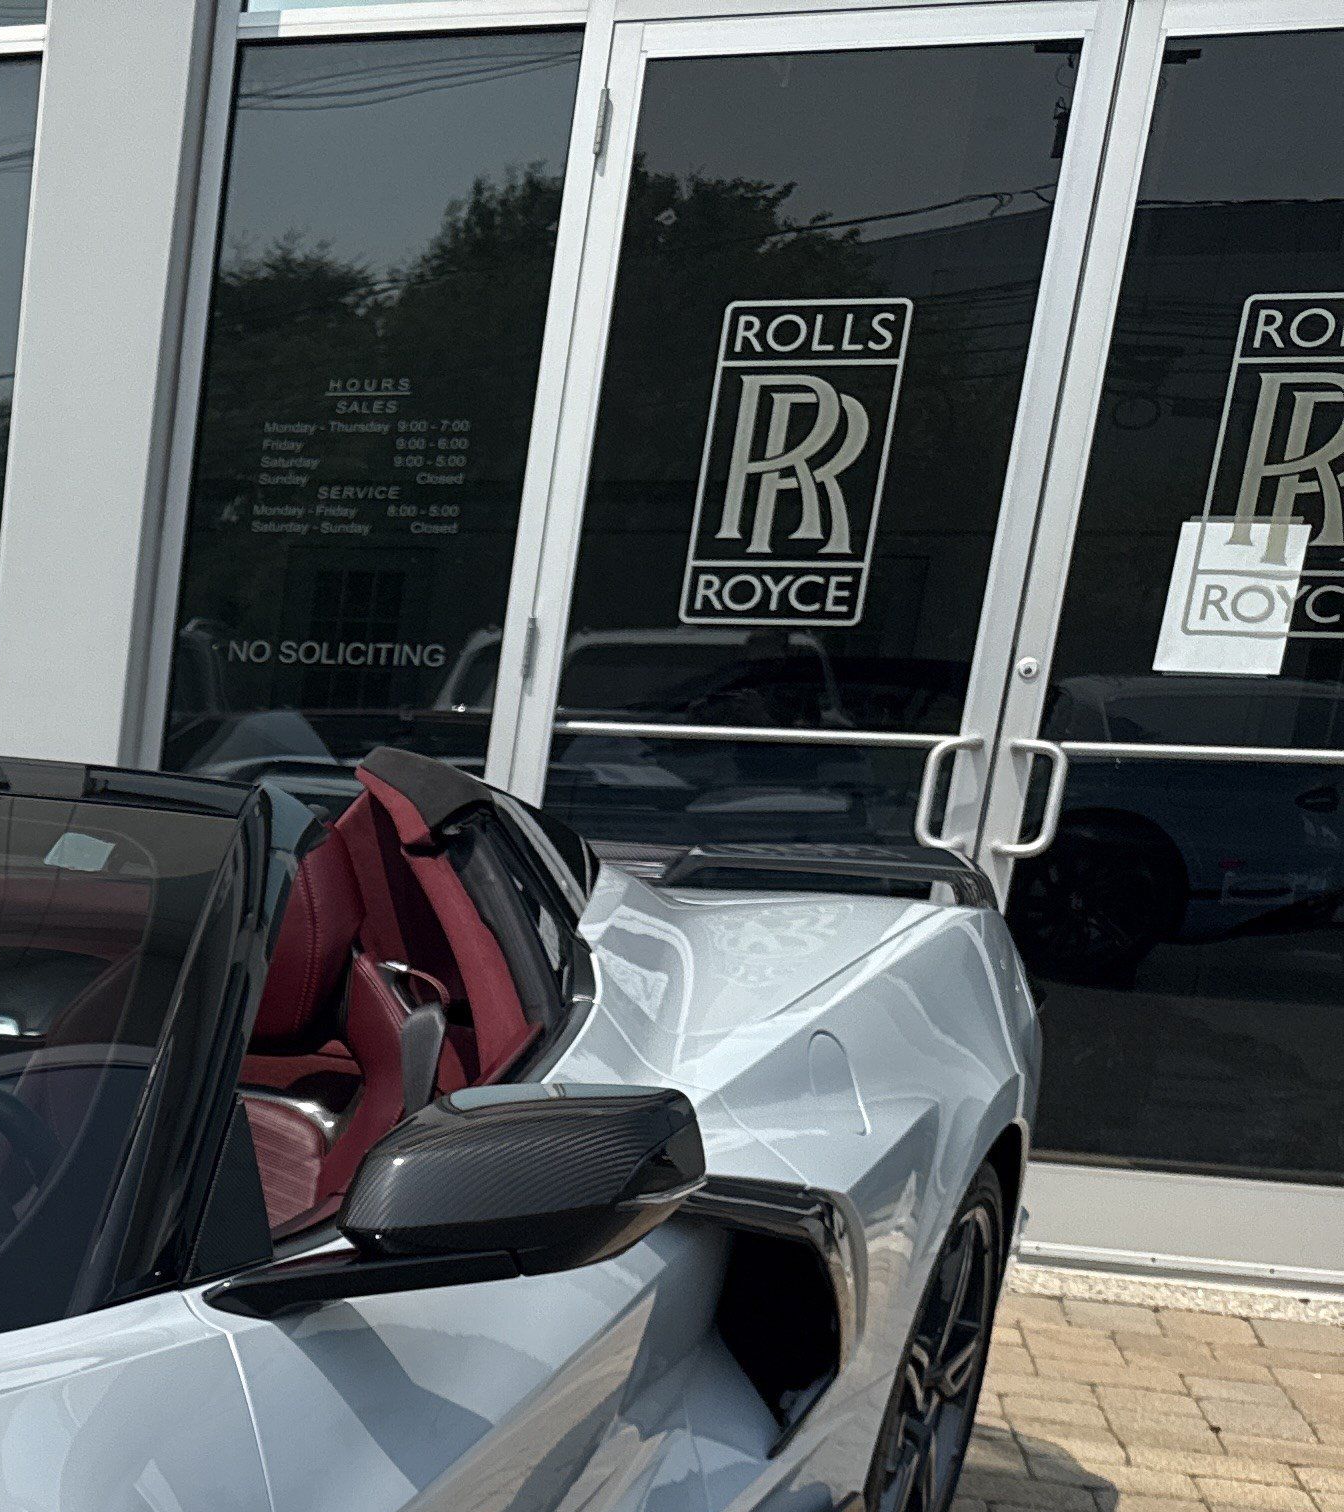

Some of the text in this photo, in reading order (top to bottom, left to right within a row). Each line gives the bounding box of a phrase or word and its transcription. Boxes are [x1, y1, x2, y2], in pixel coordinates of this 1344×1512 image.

[734, 313, 895, 352] ROLLS
[1253, 308, 1344, 349] RO
[328, 377, 412, 392] HOURS
[335, 400, 399, 415] SALES
[263, 421, 317, 435] Monday
[330, 420, 391, 435] Thursday
[262, 438, 305, 453] Friday
[260, 455, 321, 470] Saturday
[258, 472, 465, 487] Sunday Closed
[317, 486, 402, 500] SERVICE
[252, 504, 306, 518] Monday
[315, 504, 359, 519] Friday
[251, 520, 310, 536] Saturday
[320, 521, 373, 536] Sunday
[410, 521, 459, 534] Closed
[694, 573, 853, 613] ROYCE
[227, 640, 446, 668] NO SOLICITING
